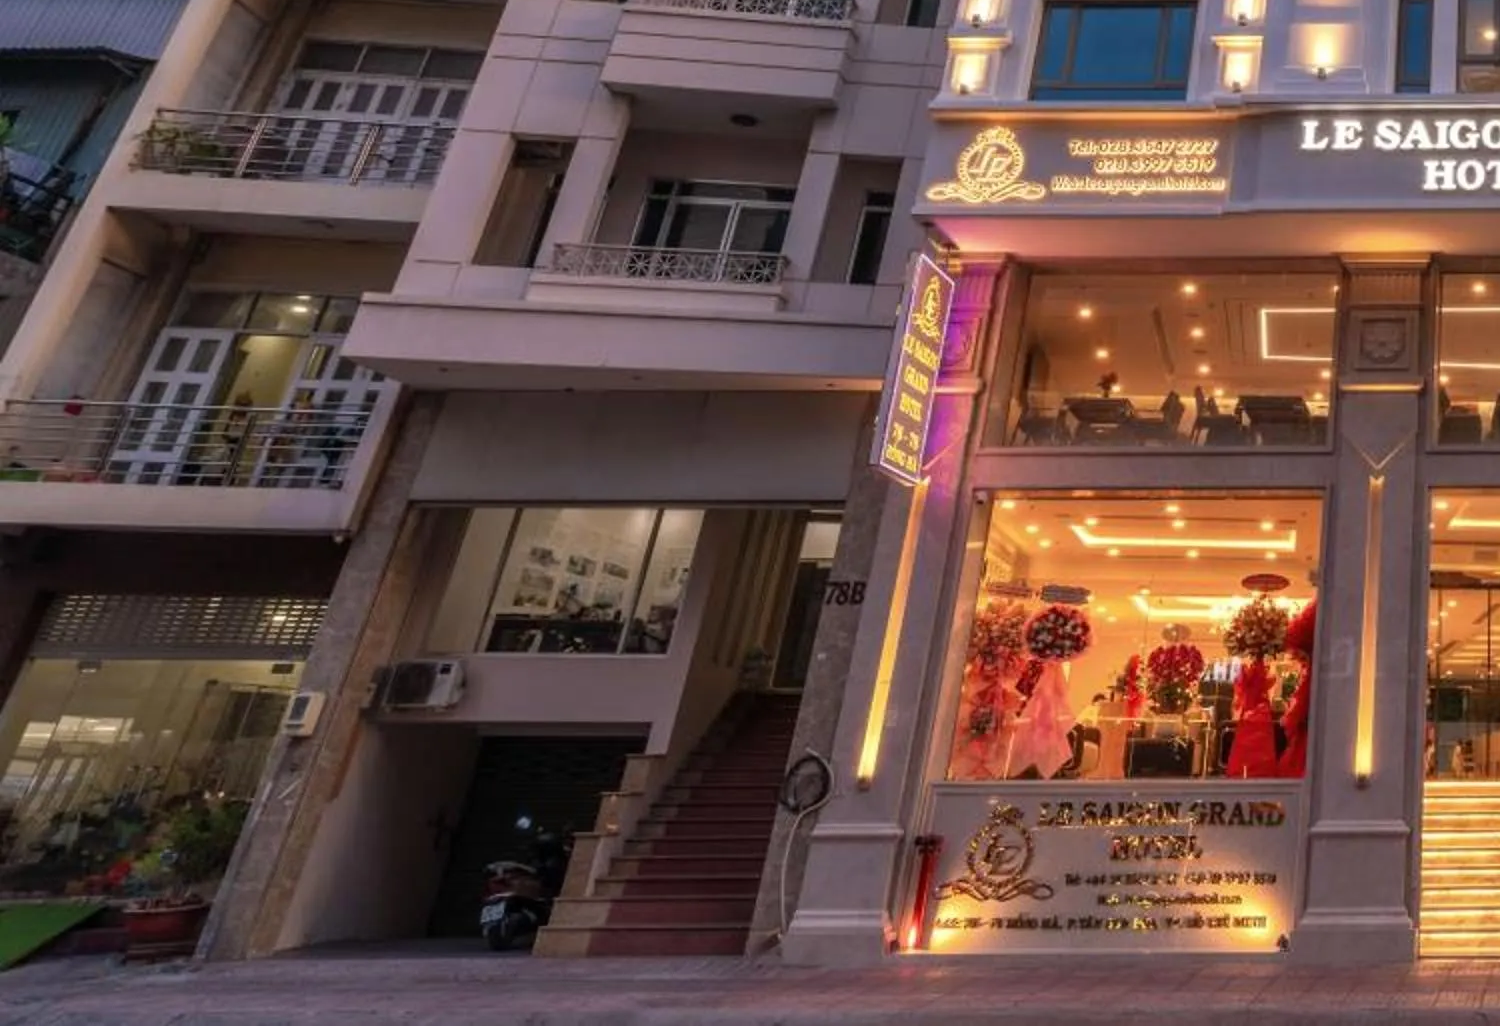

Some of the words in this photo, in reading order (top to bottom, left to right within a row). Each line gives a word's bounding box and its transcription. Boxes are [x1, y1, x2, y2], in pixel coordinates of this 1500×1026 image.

[1301, 119, 1363, 150] LE
[825, 581, 867, 606] 78B
[1192, 801, 1287, 826] GRAND
